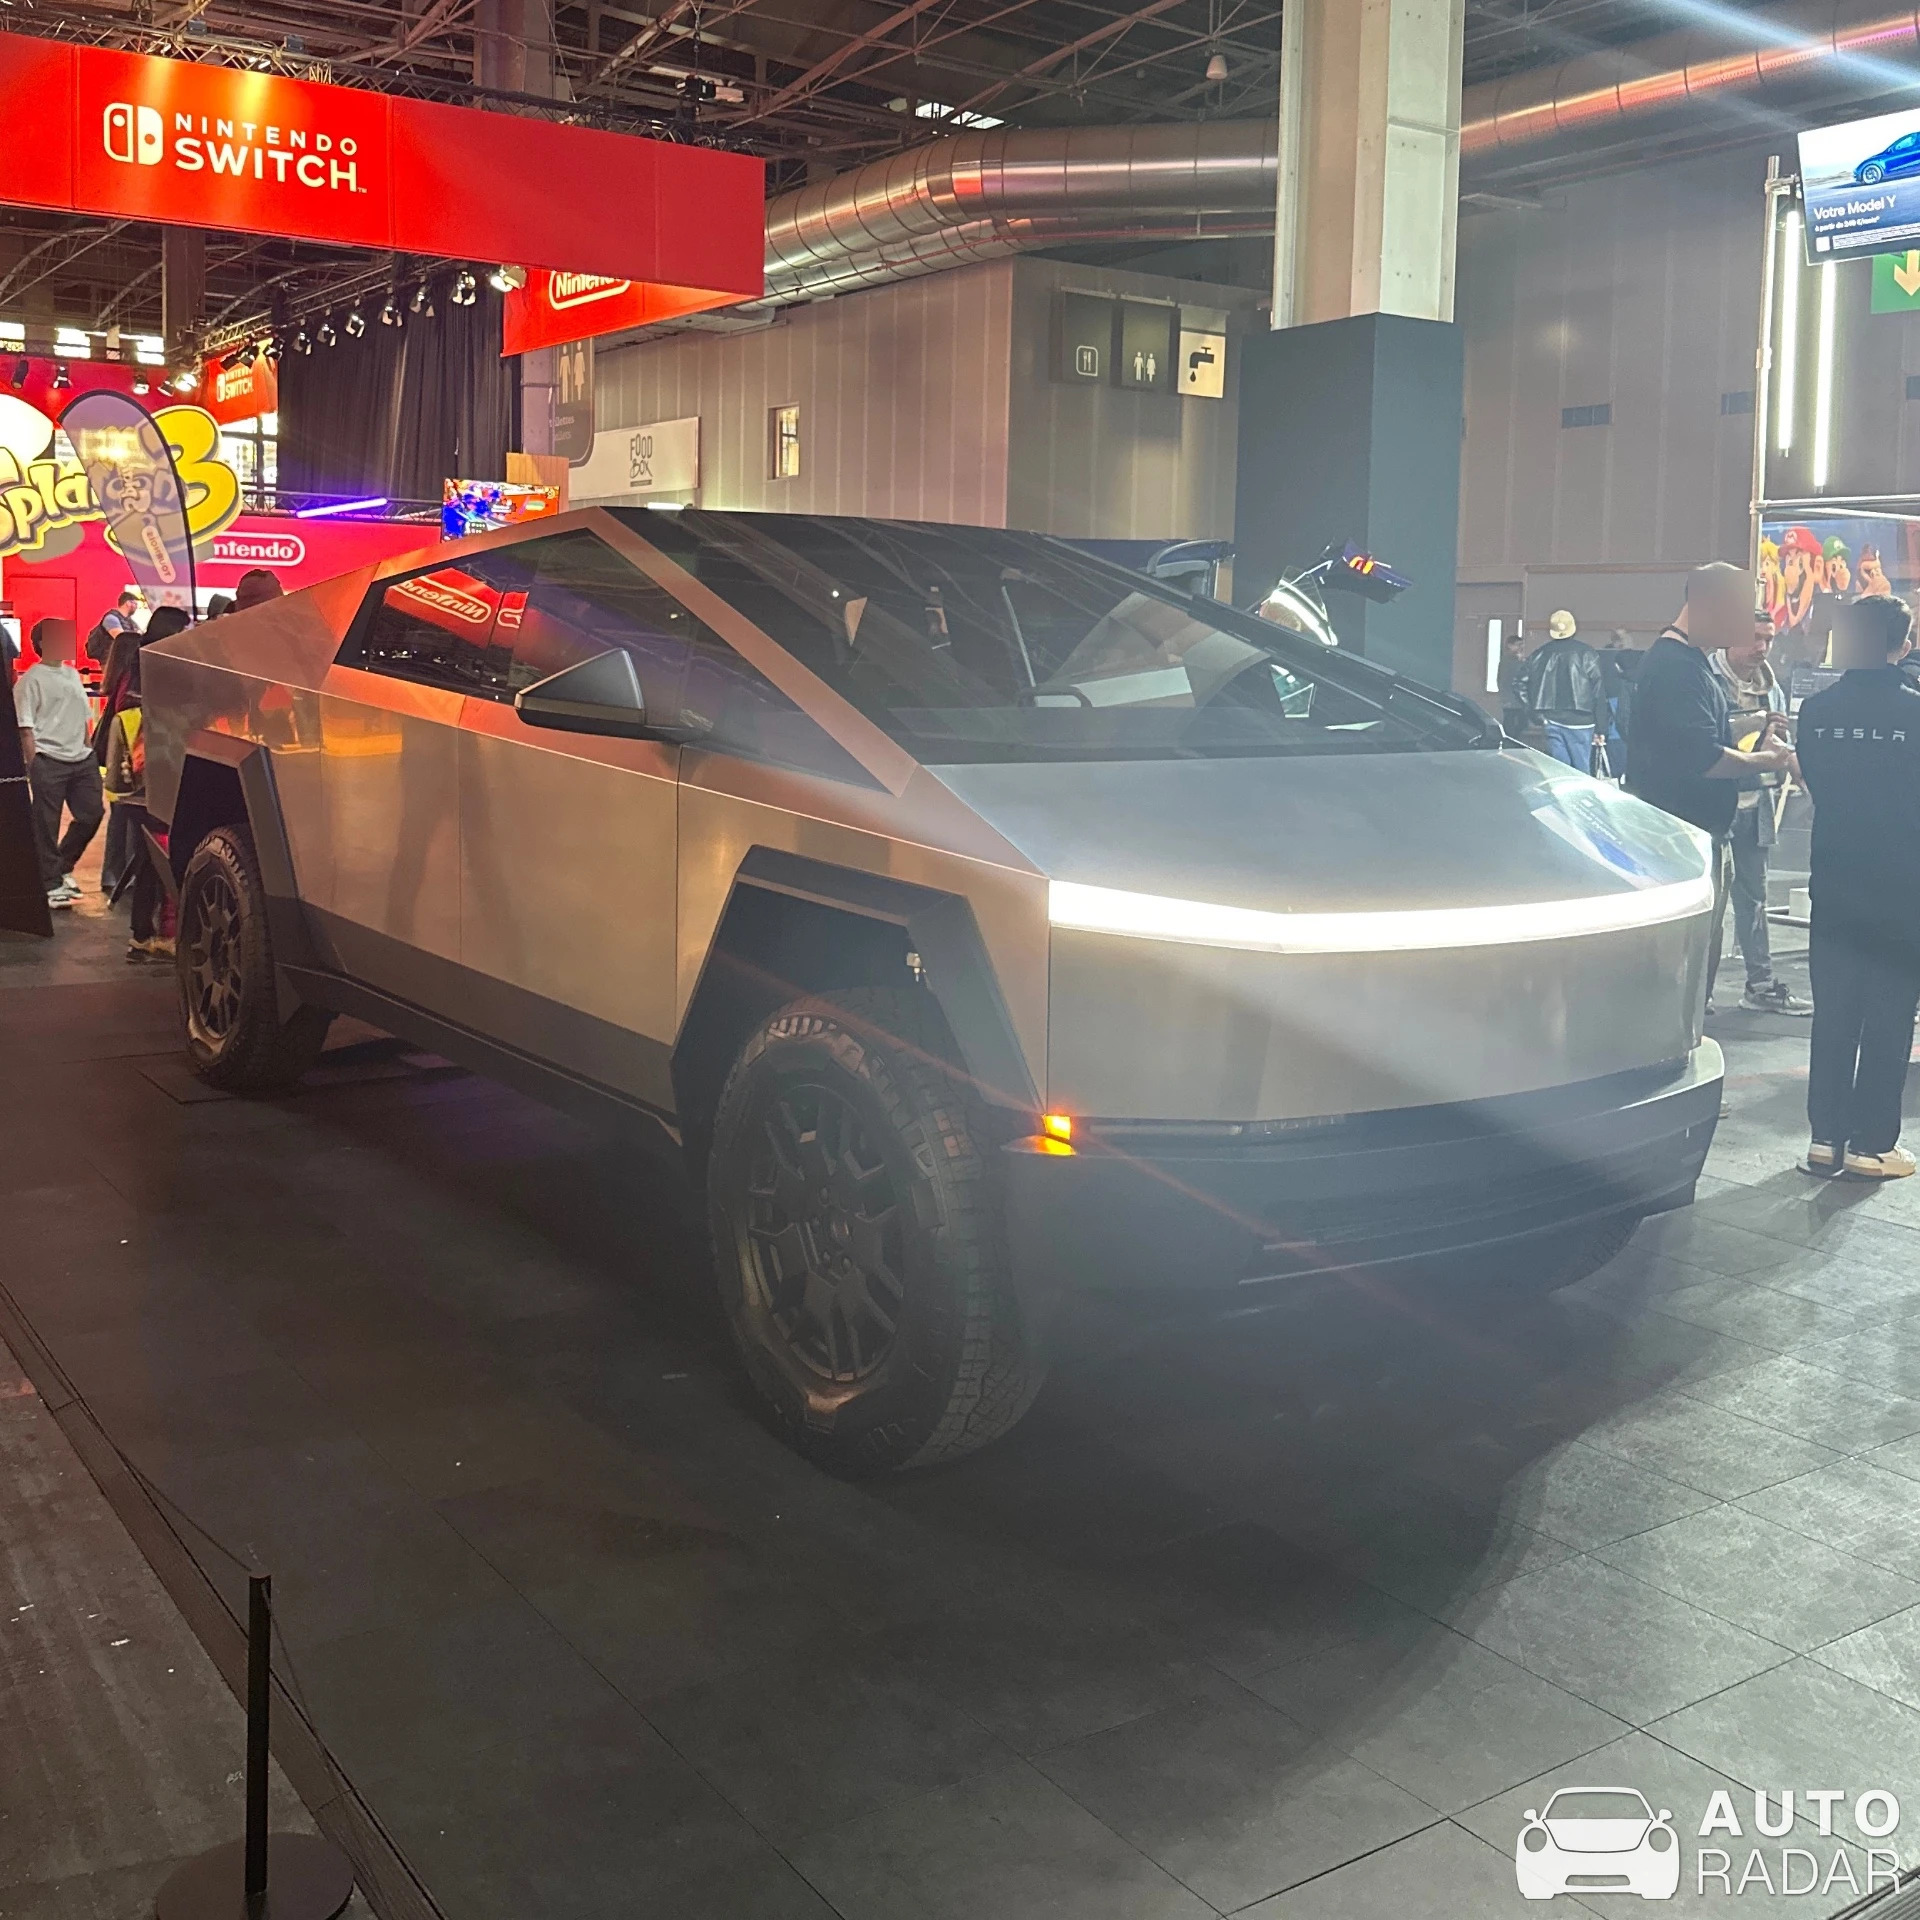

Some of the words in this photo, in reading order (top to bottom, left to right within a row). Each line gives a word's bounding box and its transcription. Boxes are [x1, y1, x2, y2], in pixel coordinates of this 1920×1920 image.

[175, 112, 358, 156] NINTENDO
[174, 137, 357, 192] SWITCH
[1814, 206, 1846, 220] Votre
[1847, 196, 1885, 215] Model
[1886, 194, 1897, 208] Y
[630, 433, 653, 461] FOOD
[213, 540, 294, 559] ntendo
[1814, 728, 1906, 742] TESLA
